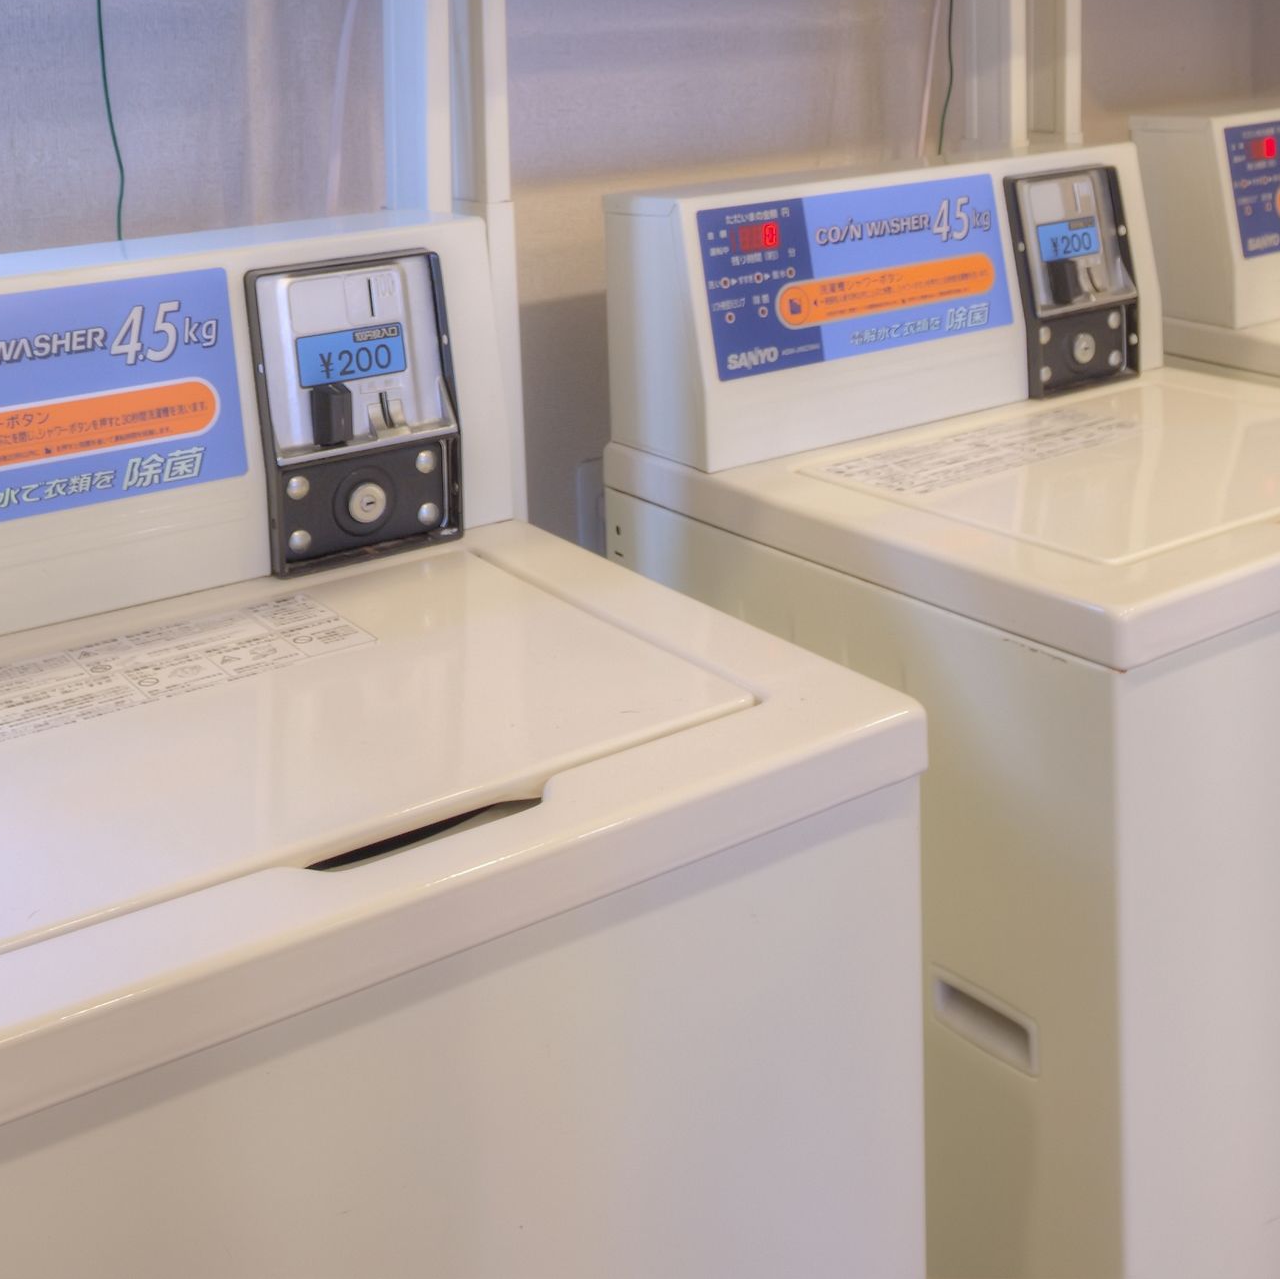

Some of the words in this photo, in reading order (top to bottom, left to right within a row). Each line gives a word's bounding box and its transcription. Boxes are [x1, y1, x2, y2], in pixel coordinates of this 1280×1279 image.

[867, 214, 932, 239] WASHER
[1050, 232, 1093, 257] ¥200
[944, 300, 992, 331] 除菌
[110, 301, 182, 367] 4.5
[184, 315, 219, 348] kg
[319, 343, 392, 379] ¥200
[727, 346, 780, 371] SANYO
[122, 445, 207, 492] 除菌
